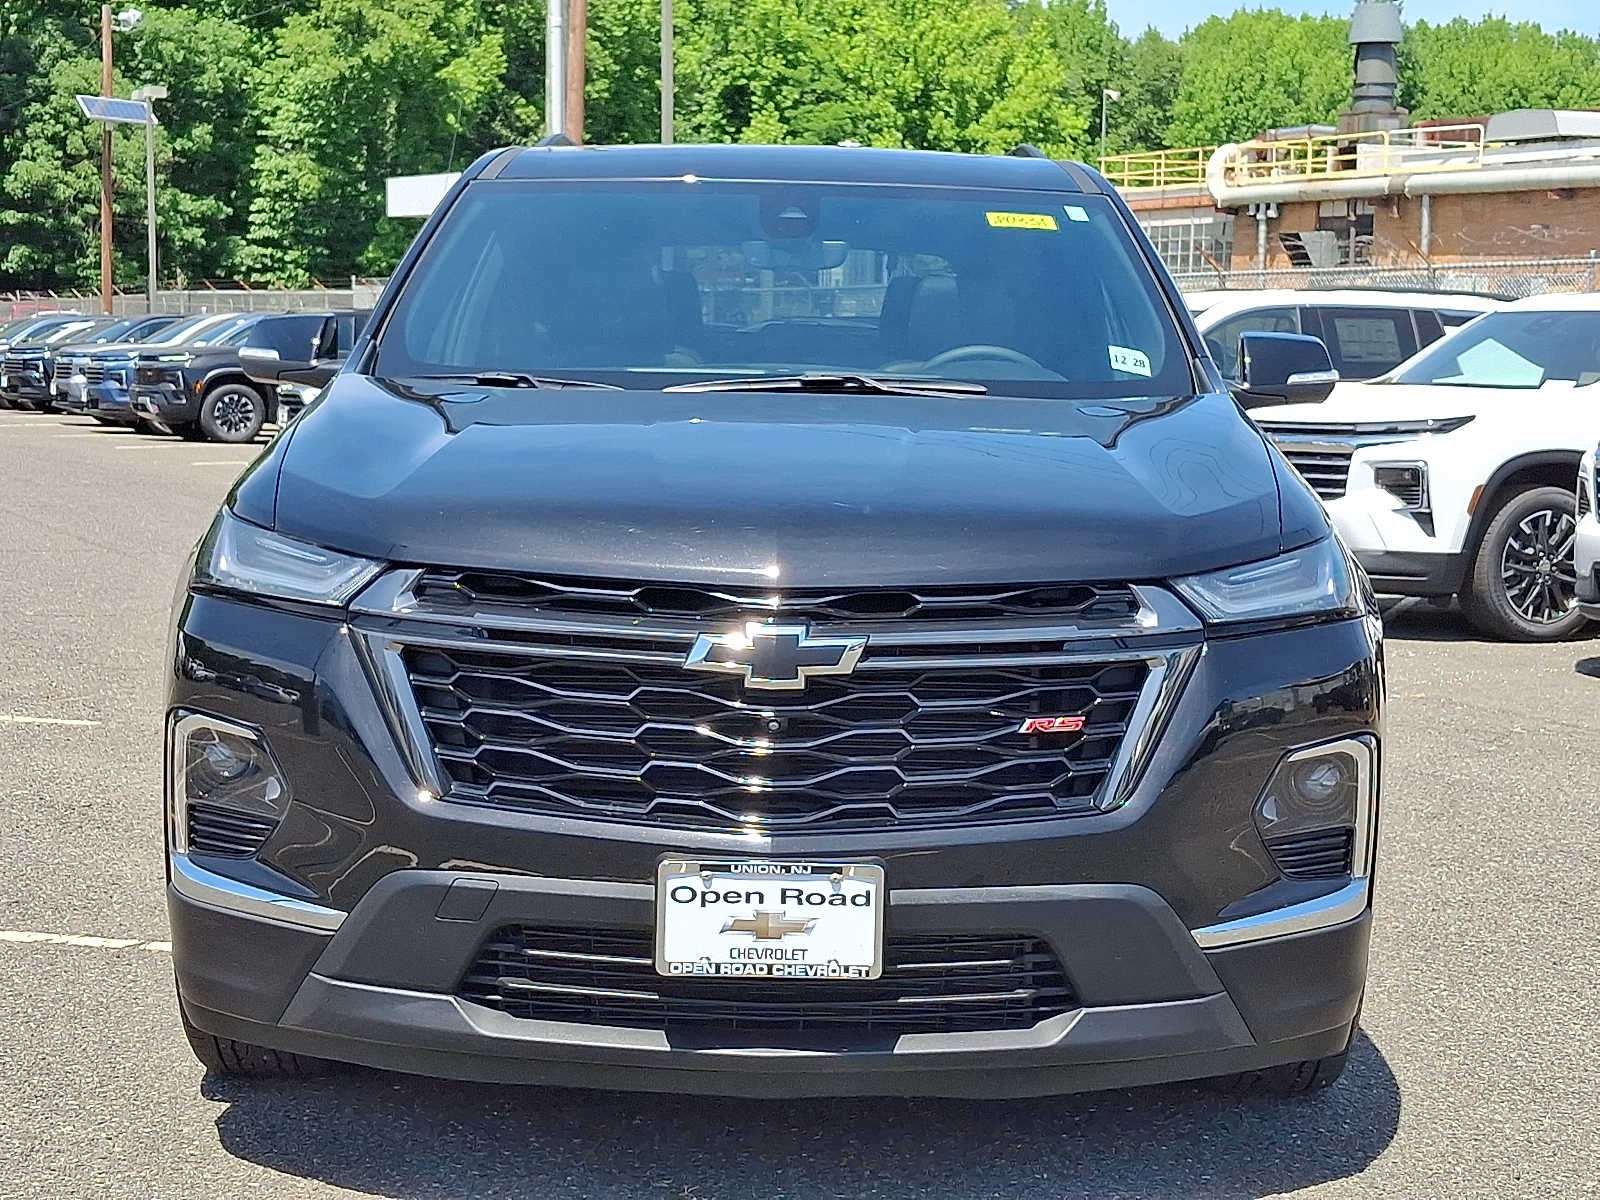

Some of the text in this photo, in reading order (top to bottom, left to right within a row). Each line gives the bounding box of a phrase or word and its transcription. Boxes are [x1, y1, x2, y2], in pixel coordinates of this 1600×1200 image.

[1018, 716, 1086, 733] RS
[730, 864, 812, 874] UNION, NJ
[670, 886, 871, 908] Open Road
[729, 947, 808, 961] CHEVROLET
[669, 962, 870, 978] OPEN ROAD CHEVROLET
